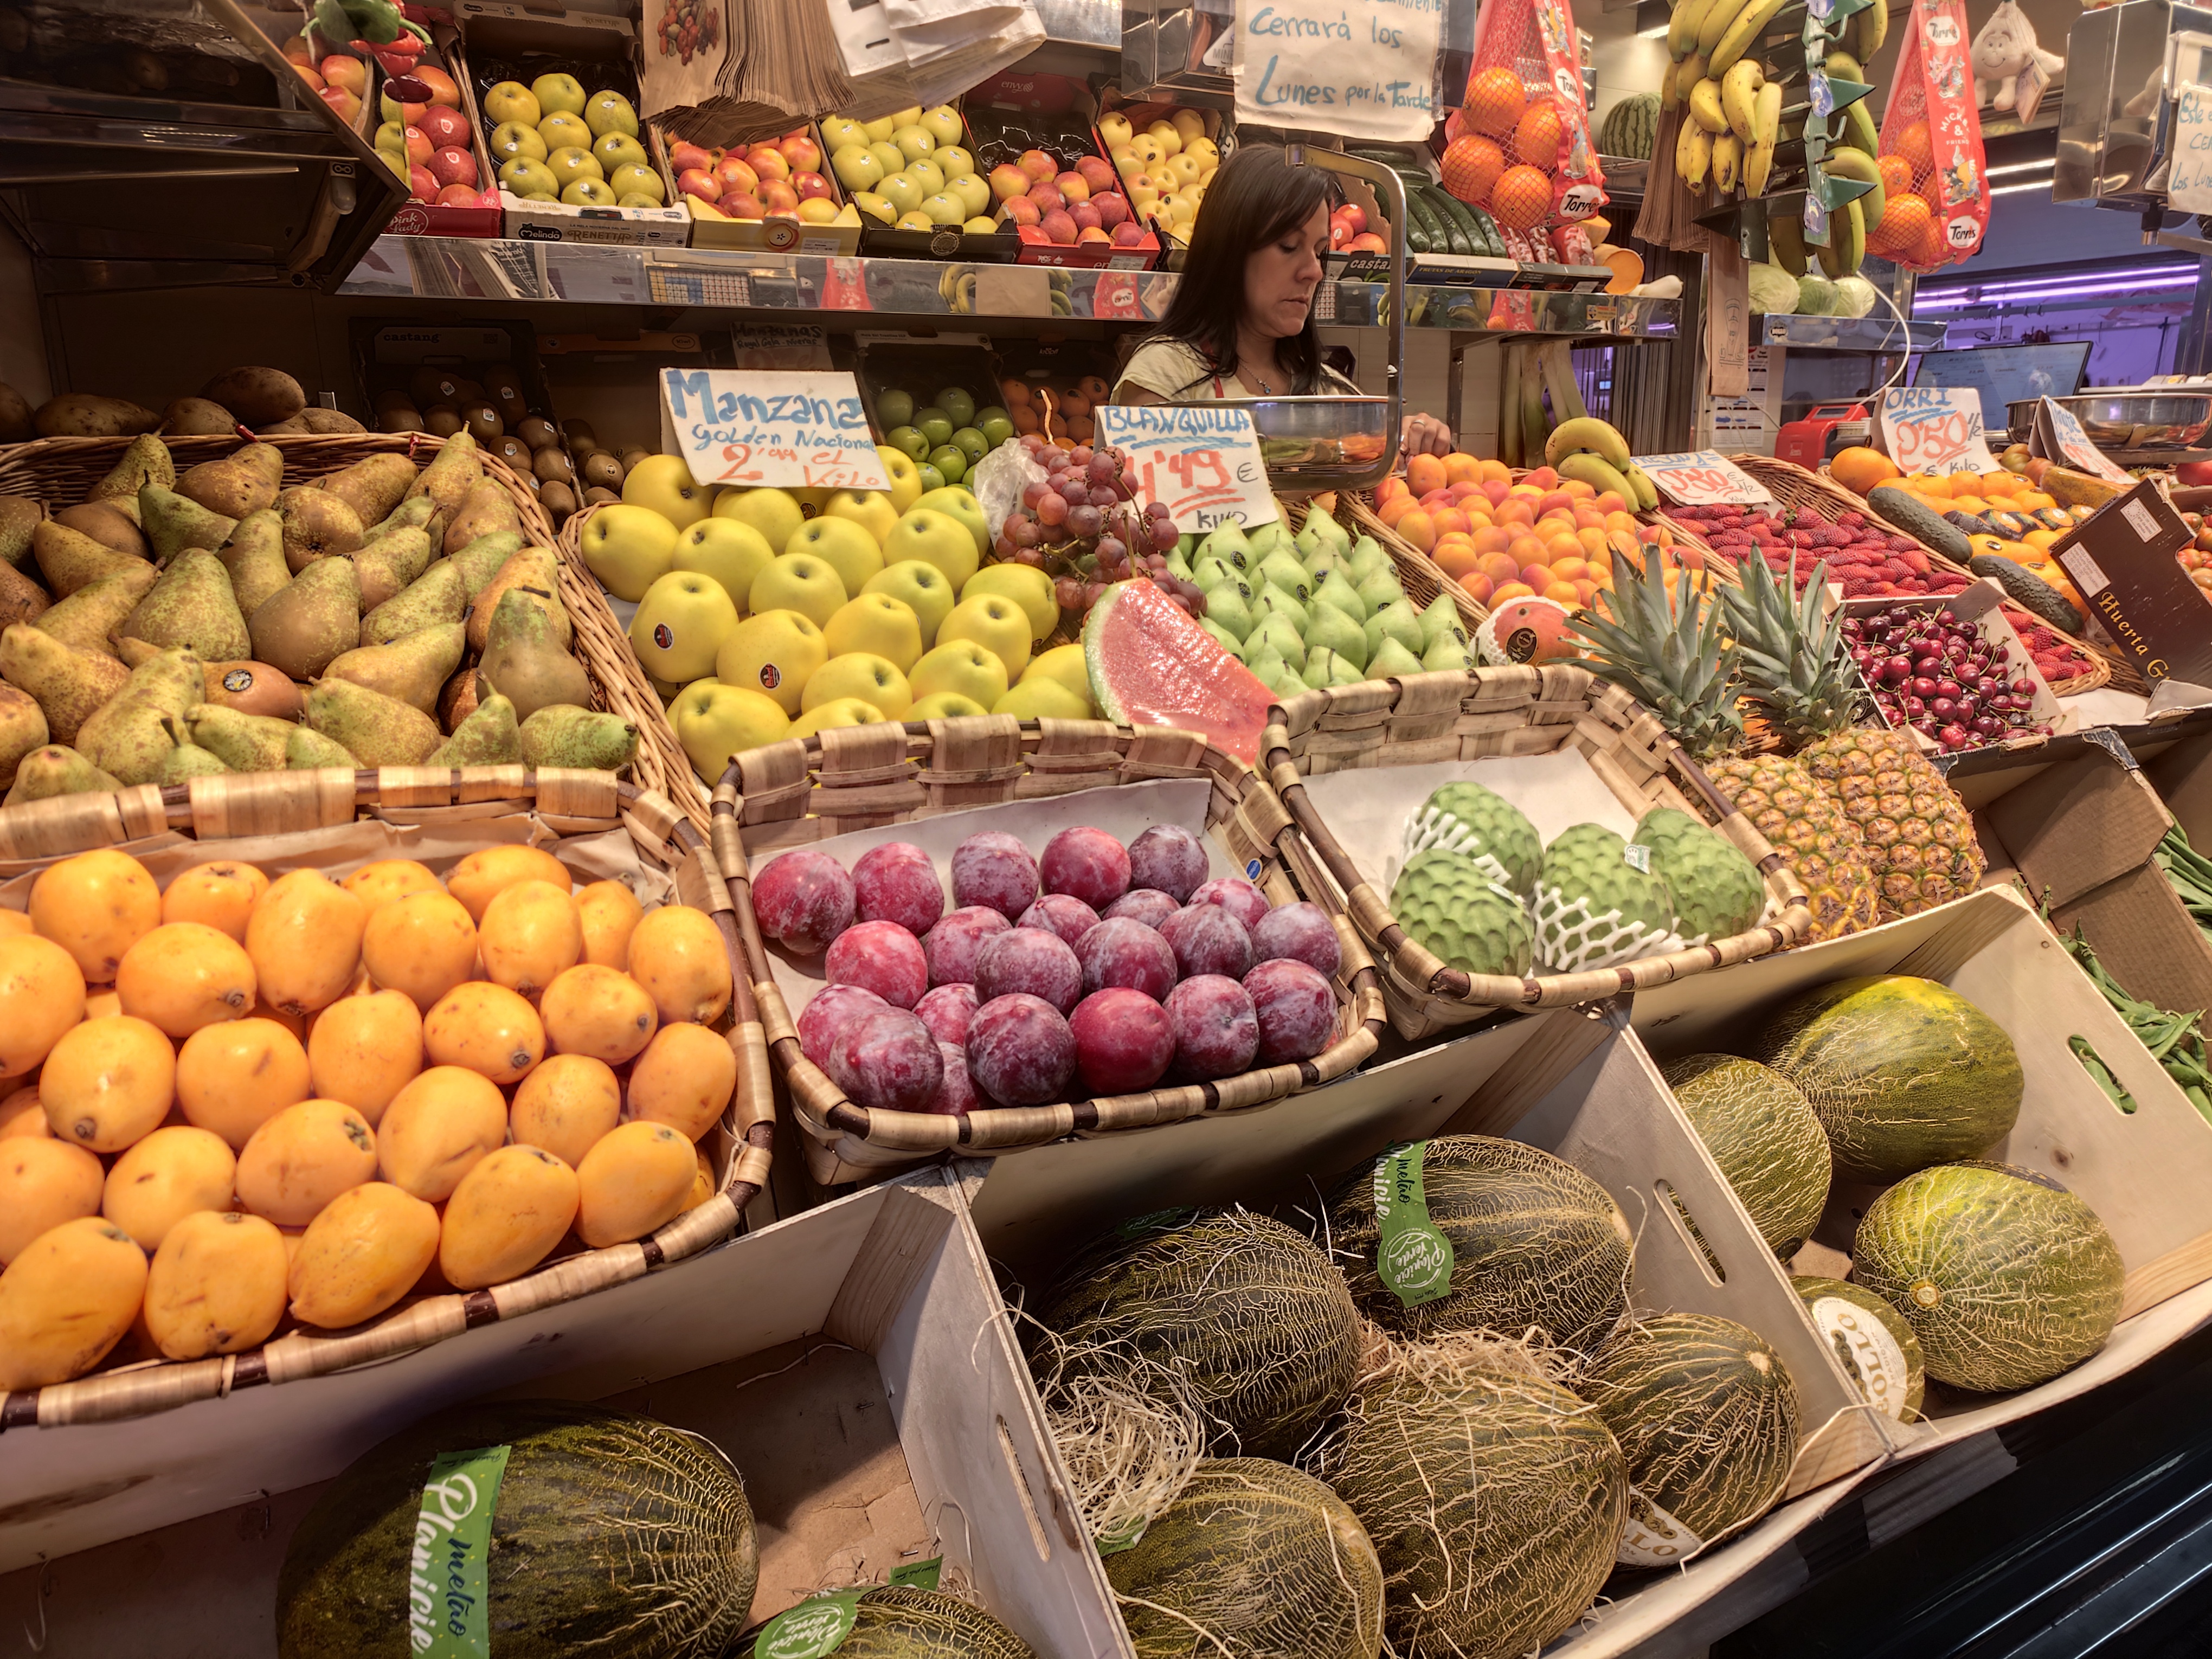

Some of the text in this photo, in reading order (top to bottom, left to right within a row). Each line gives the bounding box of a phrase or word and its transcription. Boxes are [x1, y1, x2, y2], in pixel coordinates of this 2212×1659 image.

[1249, 7, 1402, 48] Cerrará los
[1001, 81, 1024, 93] envy
[1256, 54, 1432, 111] Lunes por la Tarde
[1954, 125, 1963, 136] &
[2194, 162, 2212, 188] Lune
[1564, 194, 1600, 213] Torre
[390, 222, 421, 234] Lady
[520, 228, 561, 240] Melinda
[567, 230, 631, 243] RENETTA
[1350, 259, 1391, 269] casta
[383, 333, 440, 344] castang
[665, 368, 869, 430] Manzana
[1885, 388, 1952, 409] ORRI
[1104, 406, 1251, 434] BLANQUILLA
[795, 429, 876, 453] Nacional
[2098, 591, 2149, 656] Huerta
[1396, 1158, 1415, 1205] melão
[1395, 1241, 1428, 1266] Verde
[409, 1472, 478, 1655] Planicie
[446, 1538, 475, 1638] melão
